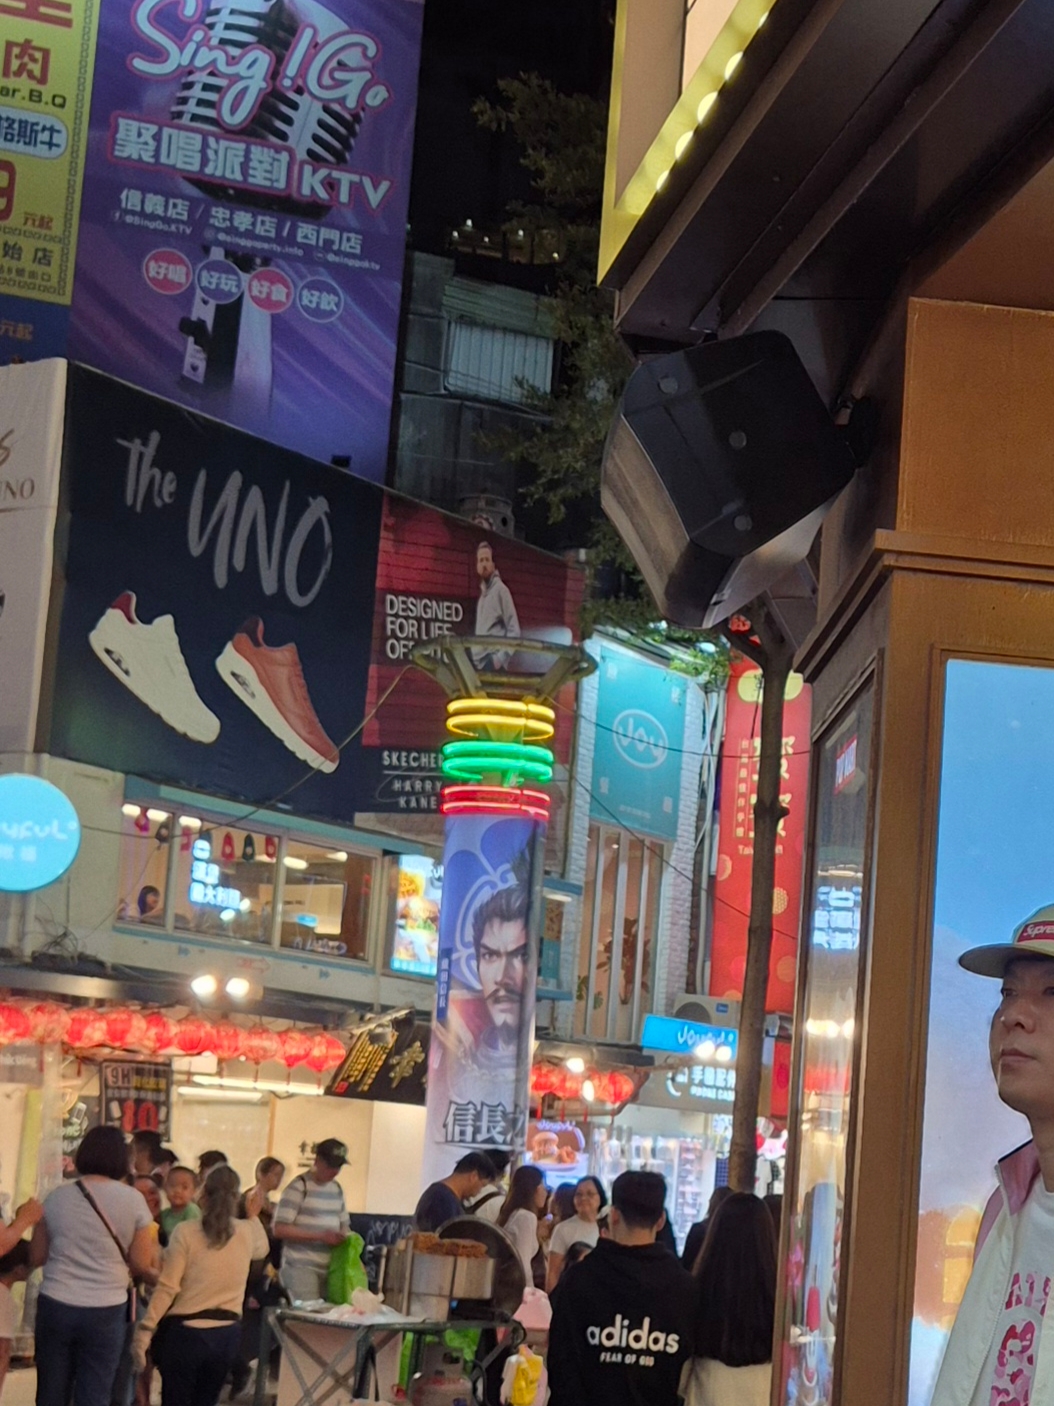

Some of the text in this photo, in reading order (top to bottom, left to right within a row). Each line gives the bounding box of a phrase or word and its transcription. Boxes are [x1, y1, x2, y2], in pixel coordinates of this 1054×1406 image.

[2, 38, 51, 86] 肉
[114, 118, 391, 209] 聚唱派對 KTV
[120, 188, 190, 220] 信義店
[209, 206, 278, 238] 忠孝店
[296, 222, 363, 254] 西門店
[148, 261, 188, 285] 好唱
[200, 270, 239, 294] 好玩
[301, 288, 339, 312] 好飲
[187, 469, 334, 608] UNO
[385, 593, 464, 623] DESIGNED
[385, 616, 418, 639] FOR
[393, 778, 443, 794] HARRY
[400, 796, 437, 810] KANE
[586, 1313, 680, 1354] adidas
[600, 1352, 622, 1363] FEAR
[624, 1353, 637, 1364] OF
